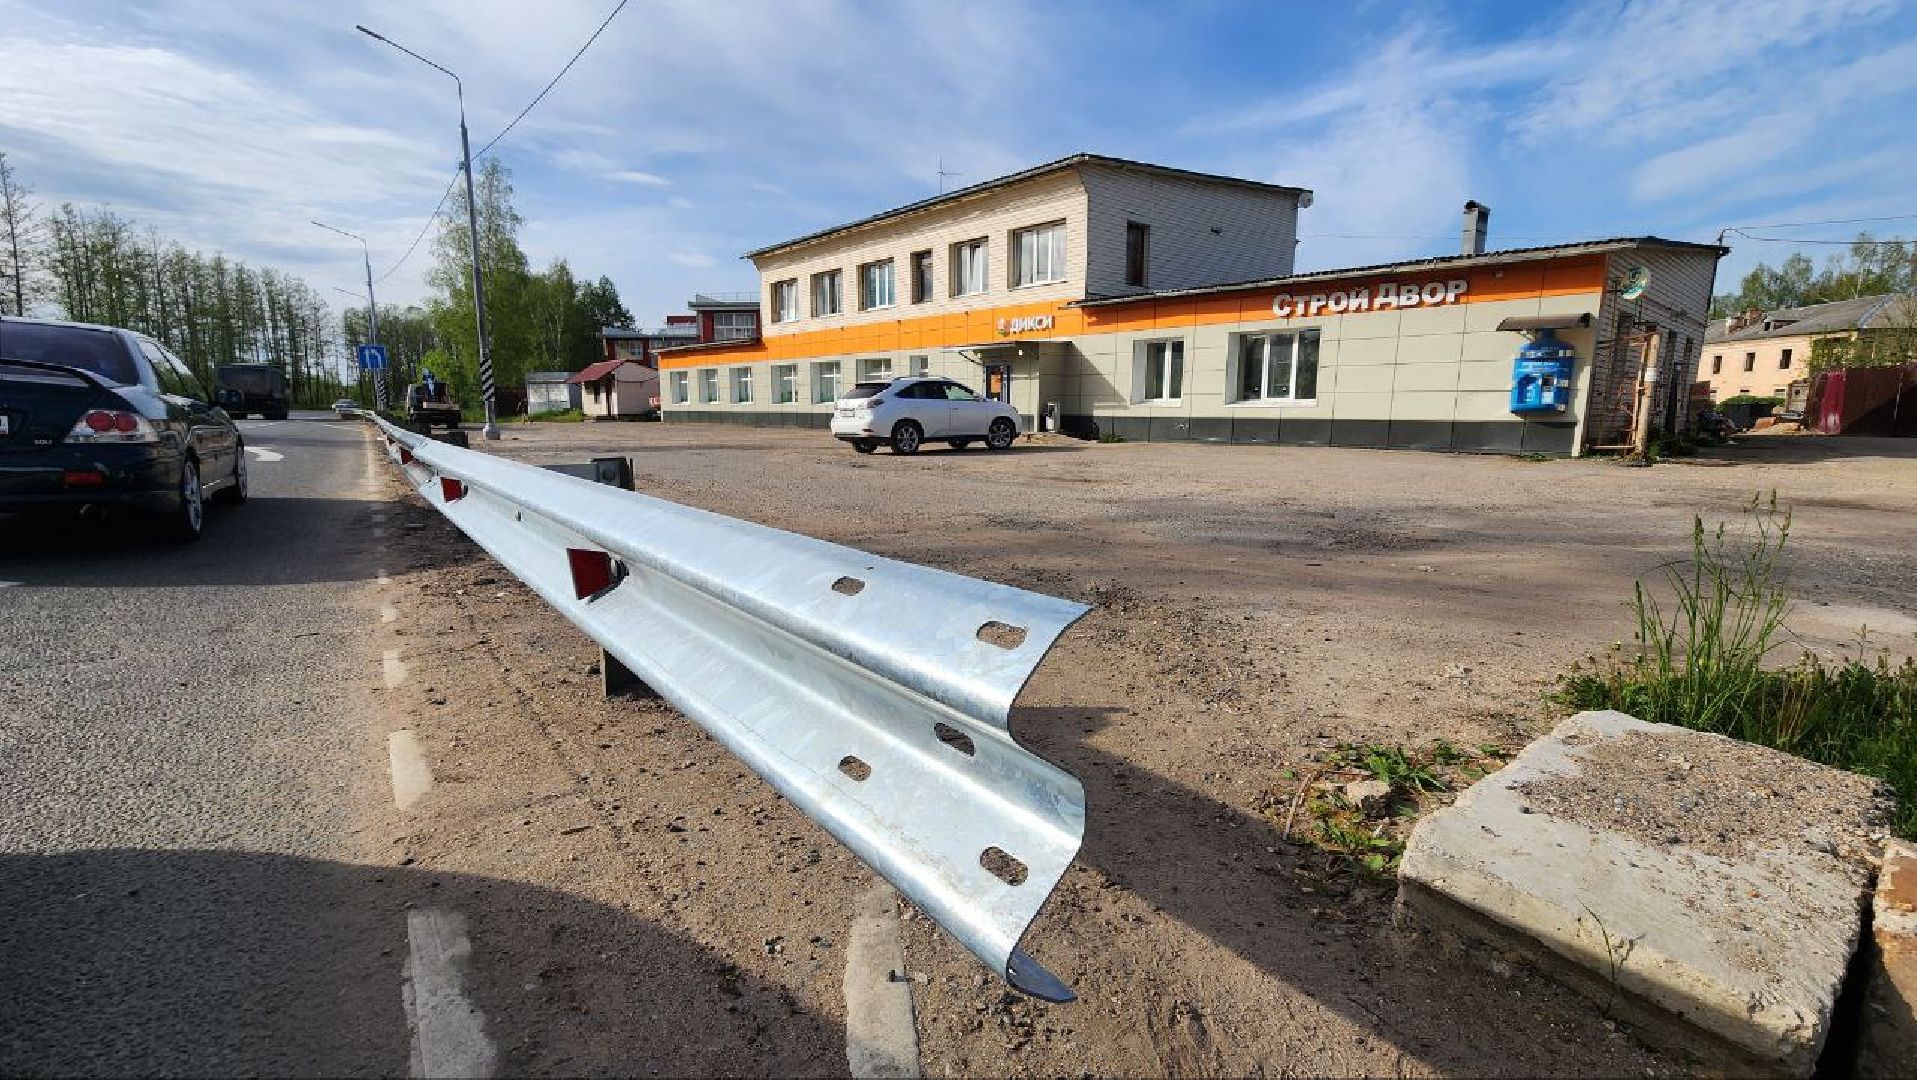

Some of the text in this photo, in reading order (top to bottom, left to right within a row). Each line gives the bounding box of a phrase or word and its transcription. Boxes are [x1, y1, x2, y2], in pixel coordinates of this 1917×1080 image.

[1272, 280, 1468, 316] СТРОЙ ДВОР
[1009, 315, 1053, 333] ДИКСИ
